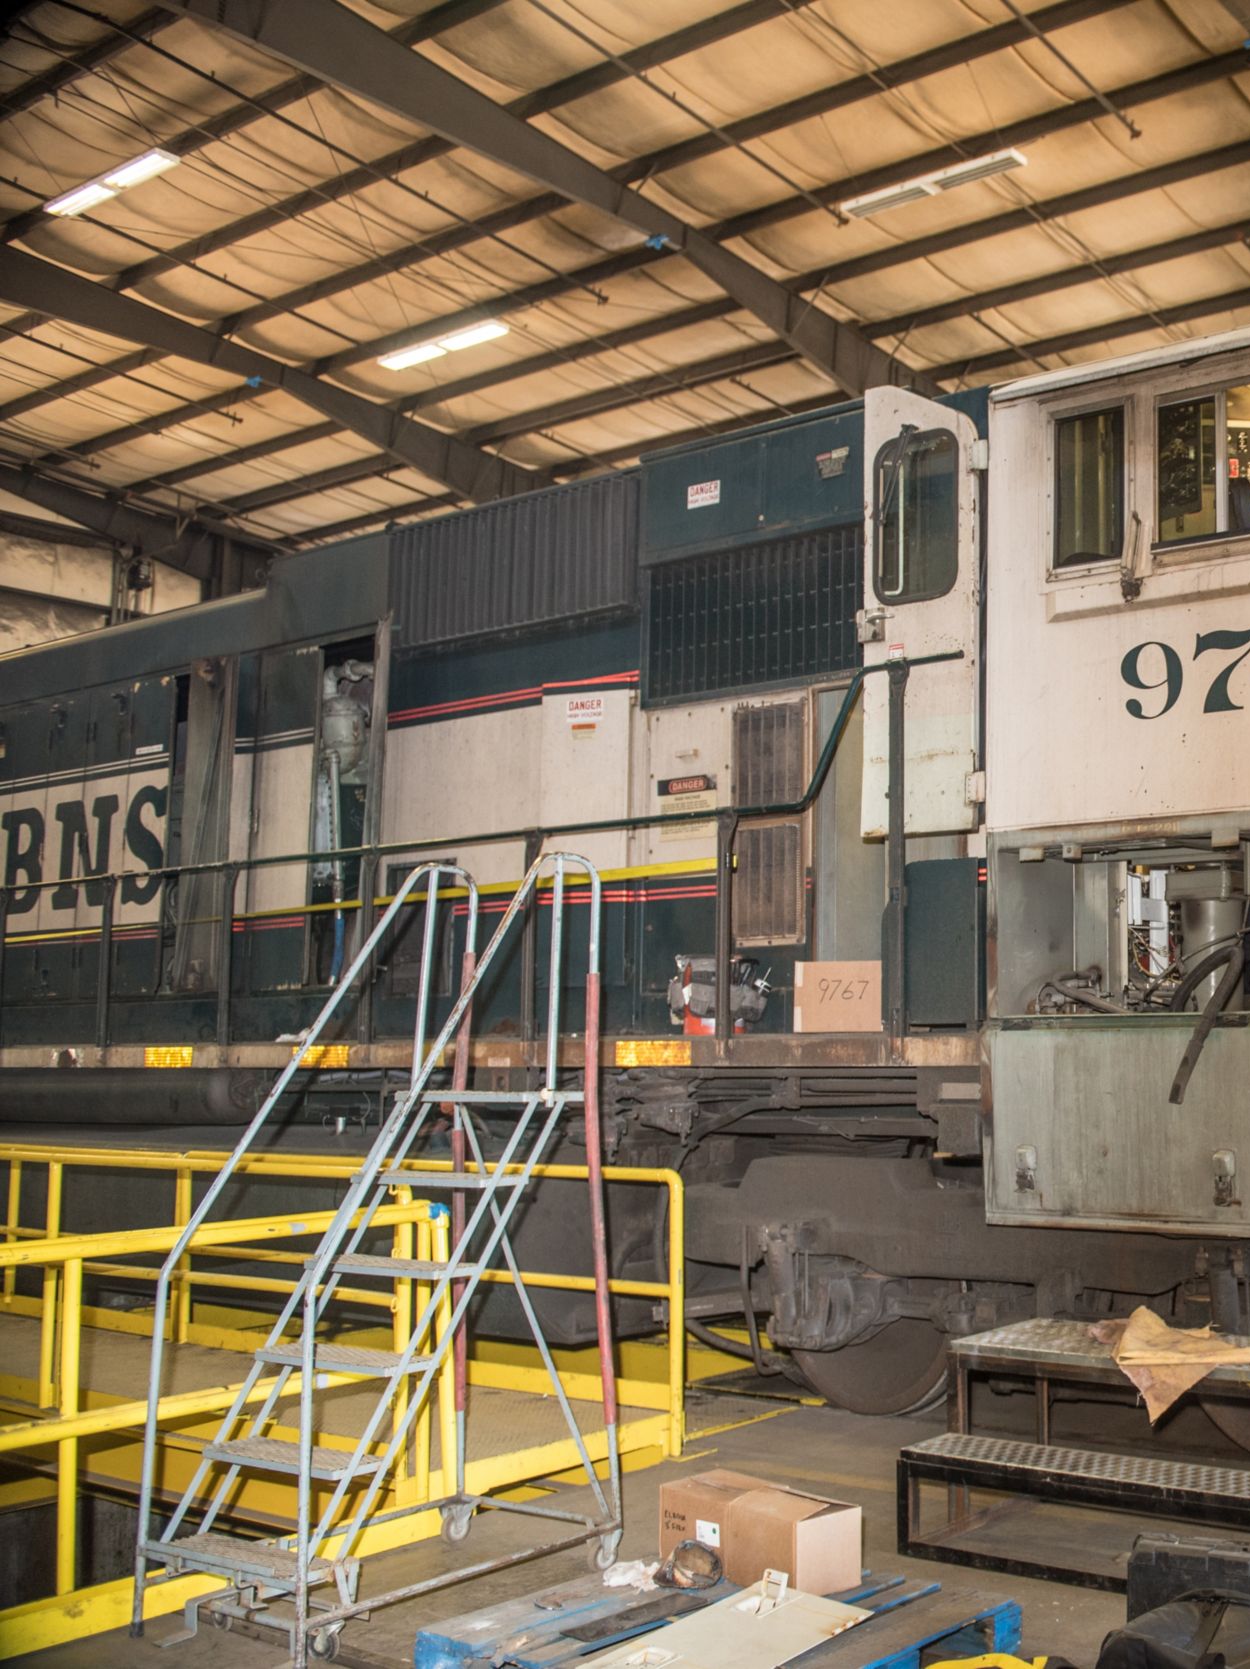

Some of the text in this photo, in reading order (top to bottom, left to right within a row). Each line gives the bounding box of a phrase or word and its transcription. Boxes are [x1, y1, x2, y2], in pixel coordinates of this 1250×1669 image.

[690, 481, 718, 497] DANGER
[568, 698, 602, 711] DANGER
[672, 778, 705, 791] DANGER
[817, 977, 870, 1004] 9767
